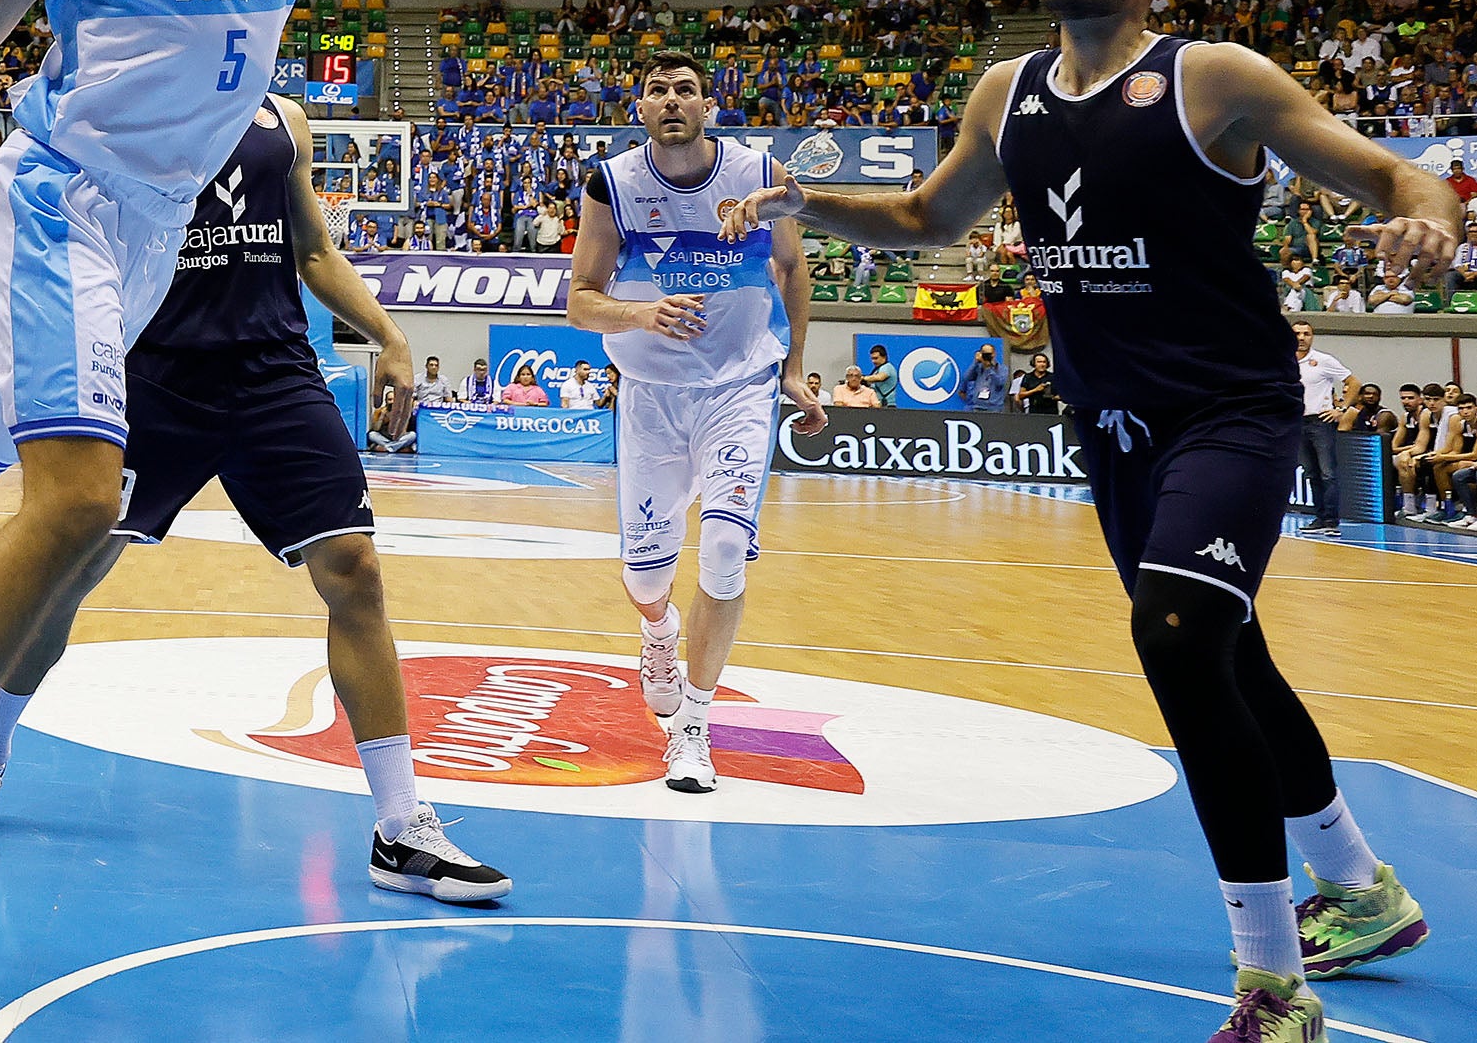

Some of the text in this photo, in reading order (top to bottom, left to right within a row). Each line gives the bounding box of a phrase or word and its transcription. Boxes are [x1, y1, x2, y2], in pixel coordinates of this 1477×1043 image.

[320, 34, 354, 50] 5:48
[216, 29, 247, 92] 5
[324, 55, 350, 84] 15
[176, 254, 228, 270] Burgos
[1027, 237, 1151, 277] ajarural
[652, 272, 732, 288] BURGOS
[495, 416, 603, 435] BURGOCAR
[777, 410, 1088, 478] CaixaBank
